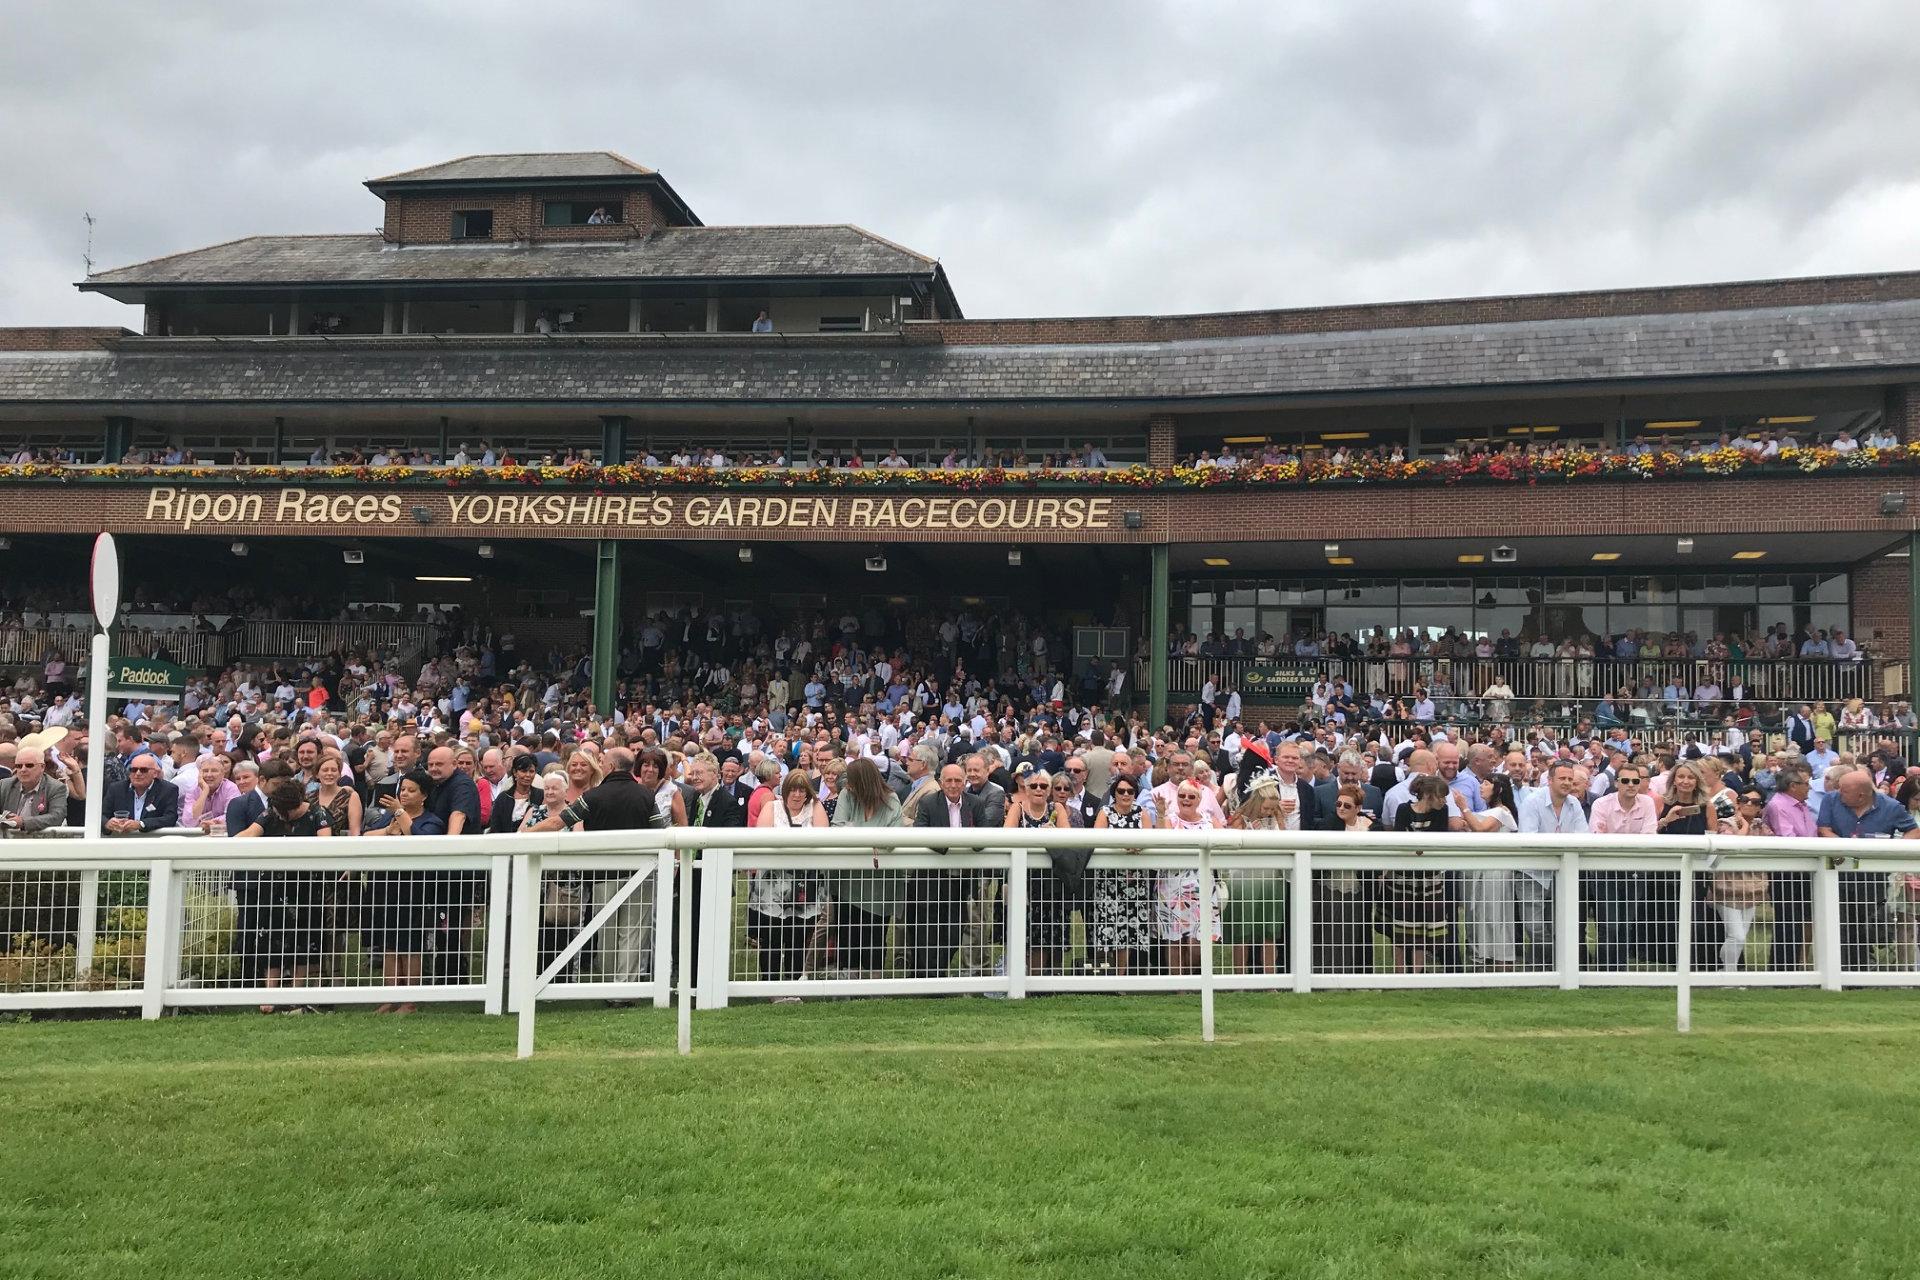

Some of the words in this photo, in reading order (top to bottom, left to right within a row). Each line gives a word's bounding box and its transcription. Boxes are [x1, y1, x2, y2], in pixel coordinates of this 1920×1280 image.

[145, 487, 263, 530] Ripon
[275, 488, 402, 523] Races
[447, 489, 673, 526] YORKSHIRE'S
[684, 497, 839, 527] GARDEN
[848, 498, 1112, 528] RACECOURSE
[120, 666, 171, 685] Paddock
